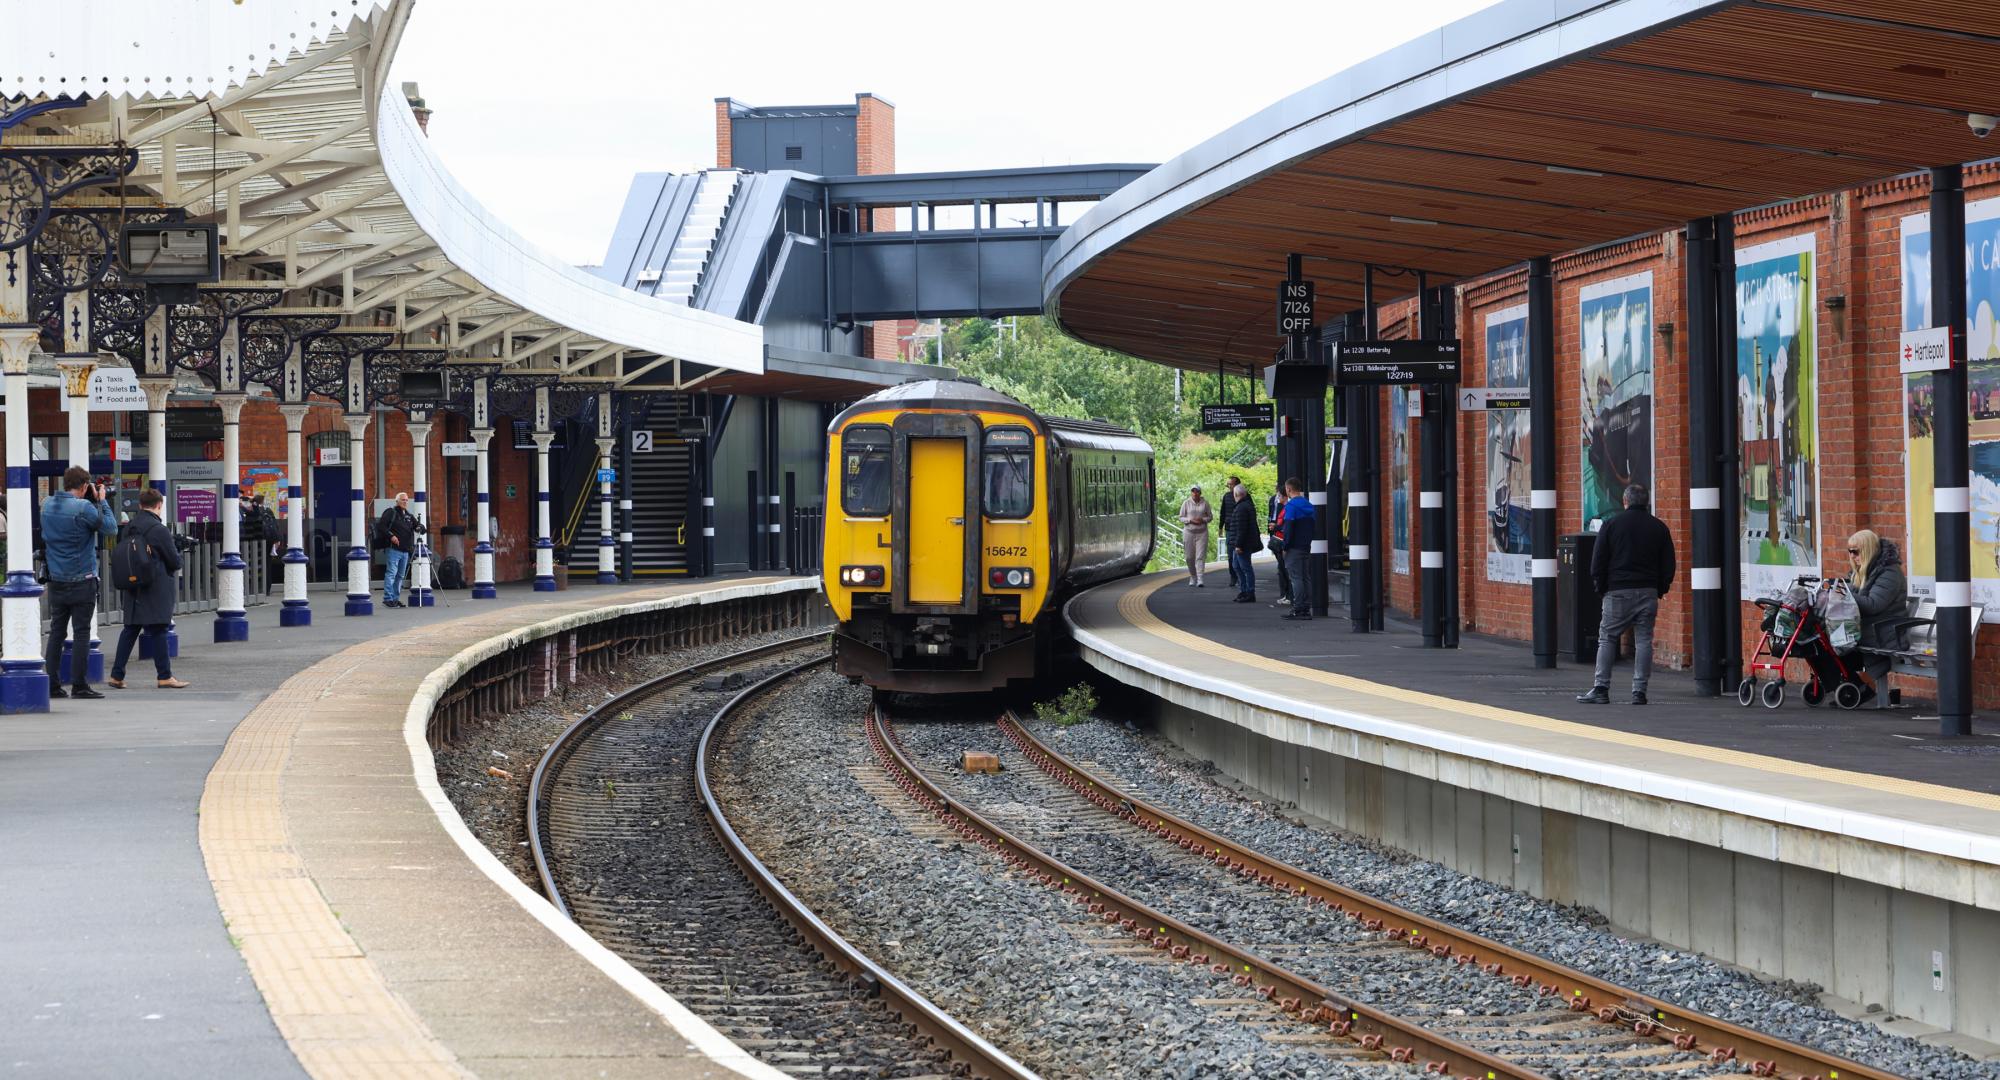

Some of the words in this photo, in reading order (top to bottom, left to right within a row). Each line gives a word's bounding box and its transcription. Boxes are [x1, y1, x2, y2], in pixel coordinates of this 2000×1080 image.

[1287, 285, 1307, 297] NS
[1766, 271, 1798, 302] STREET
[1284, 301, 1310, 313] 7126
[1283, 317, 1311, 330] OFF
[1914, 343, 1946, 363] Hartlepool
[1387, 371, 1414, 380] 12:27:19
[635, 432, 649, 450] 2
[985, 546, 1027, 556] 156472
